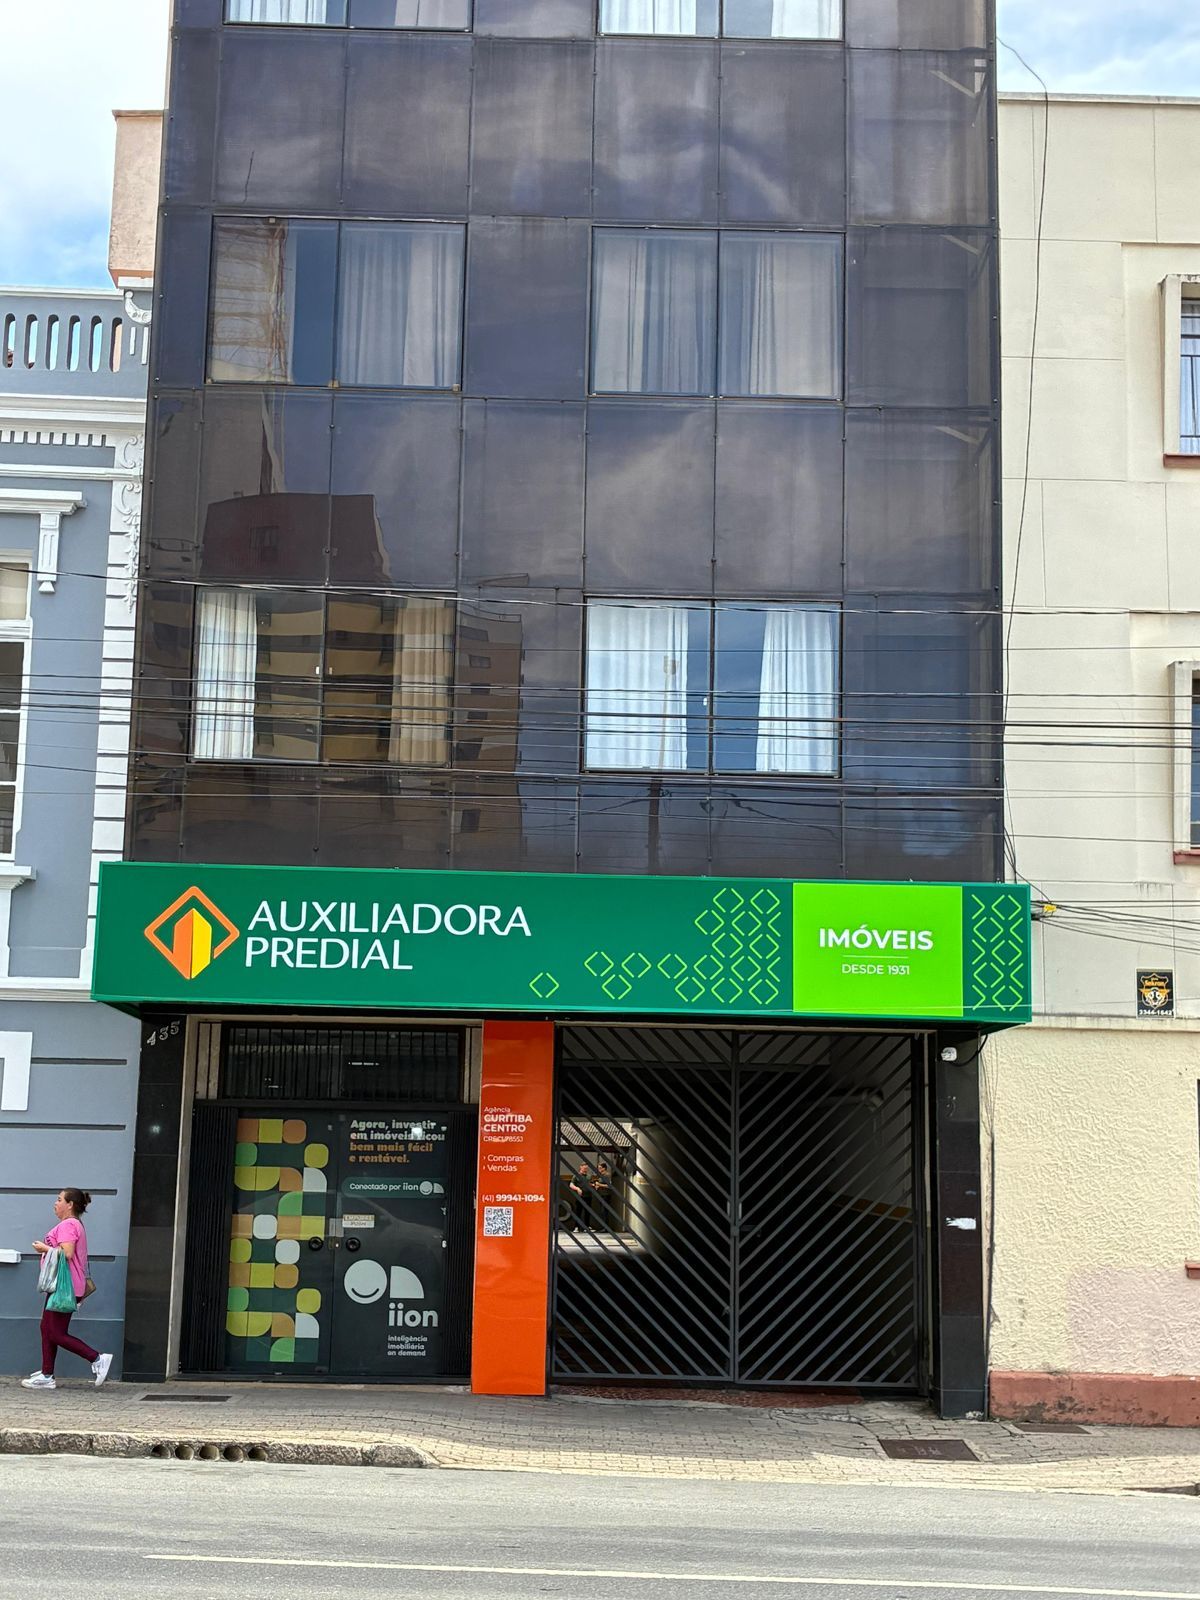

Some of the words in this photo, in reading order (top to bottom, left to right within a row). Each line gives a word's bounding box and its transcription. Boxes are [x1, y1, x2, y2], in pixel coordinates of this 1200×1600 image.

[248, 900, 532, 937] AUXILIADORA
[818, 923, 934, 951] IMÓVEIS
[245, 936, 413, 971] PREDIAL
[841, 963, 884, 975] DESDE
[887, 964, 910, 975] 1931
[146, 1020, 181, 1046] 435
[484, 1106, 511, 1114] Agência
[484, 1114, 533, 1123] CURITIBA
[350, 1120, 389, 1131] Agora,
[392, 1120, 436, 1130] investir
[483, 1123, 526, 1133] CENTRO
[350, 1132, 368, 1140] em
[349, 1142, 374, 1151] bem
[377, 1142, 405, 1152] mais
[408, 1142, 433, 1152] fácil
[349, 1154, 356, 1162] e
[359, 1154, 410, 1163] rentável.
[487, 1154, 524, 1163] Compras
[487, 1164, 517, 1172] Vendas
[388, 1184, 401, 1192] por
[403, 1183, 419, 1191] iion
[482, 1194, 494, 1203] (41)
[496, 1194, 545, 1202] 99941-1094
[388, 1302, 439, 1327] iion
[388, 1335, 428, 1343] inteligência
